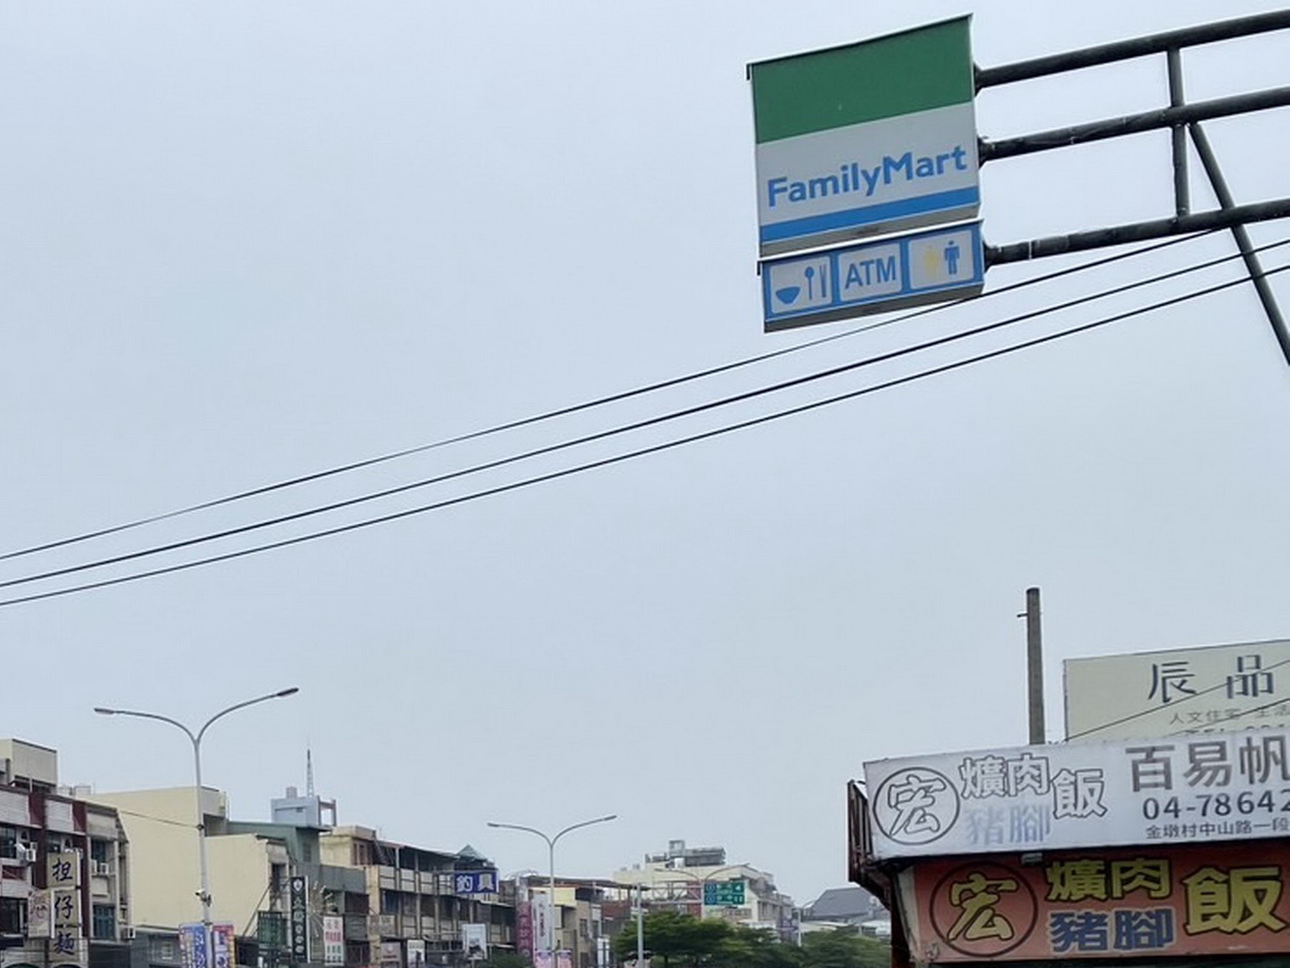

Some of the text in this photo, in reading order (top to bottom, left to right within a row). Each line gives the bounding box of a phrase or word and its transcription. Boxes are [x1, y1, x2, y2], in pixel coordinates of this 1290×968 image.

[767, 145, 967, 207] FamilyMart
[845, 256, 897, 289] ATM
[887, 776, 947, 837] 宏
[946, 873, 1017, 944] 宏
[1048, 907, 1177, 953] 豬腳
